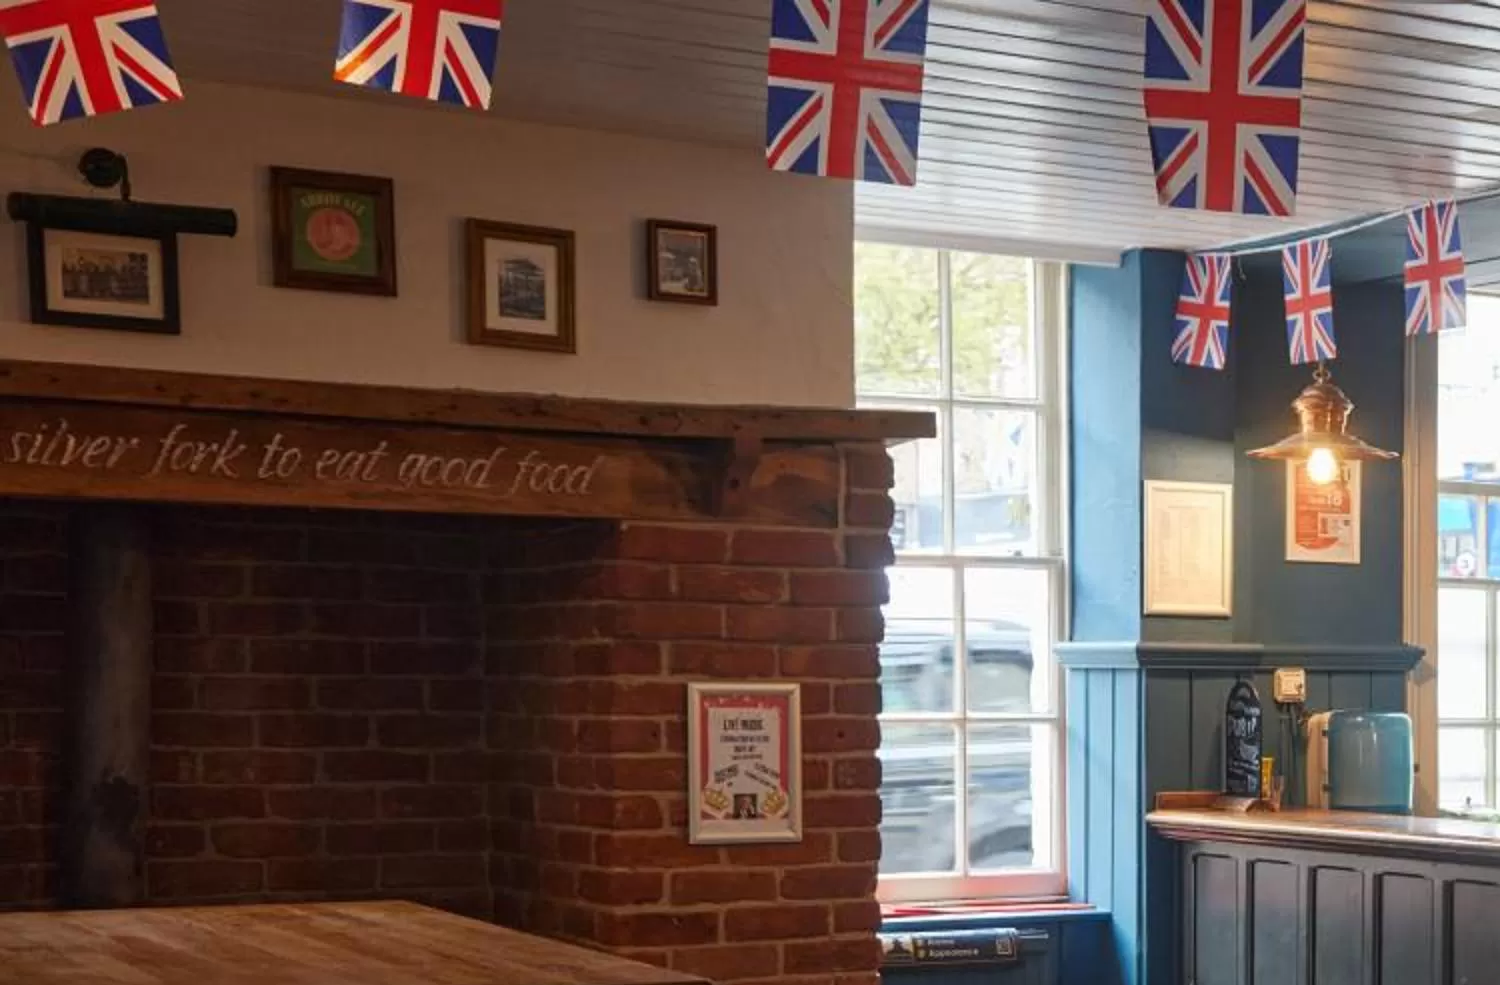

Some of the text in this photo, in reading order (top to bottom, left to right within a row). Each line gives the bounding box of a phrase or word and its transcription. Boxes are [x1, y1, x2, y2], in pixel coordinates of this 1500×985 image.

[4, 418, 606, 496] silver fork to eat good food
